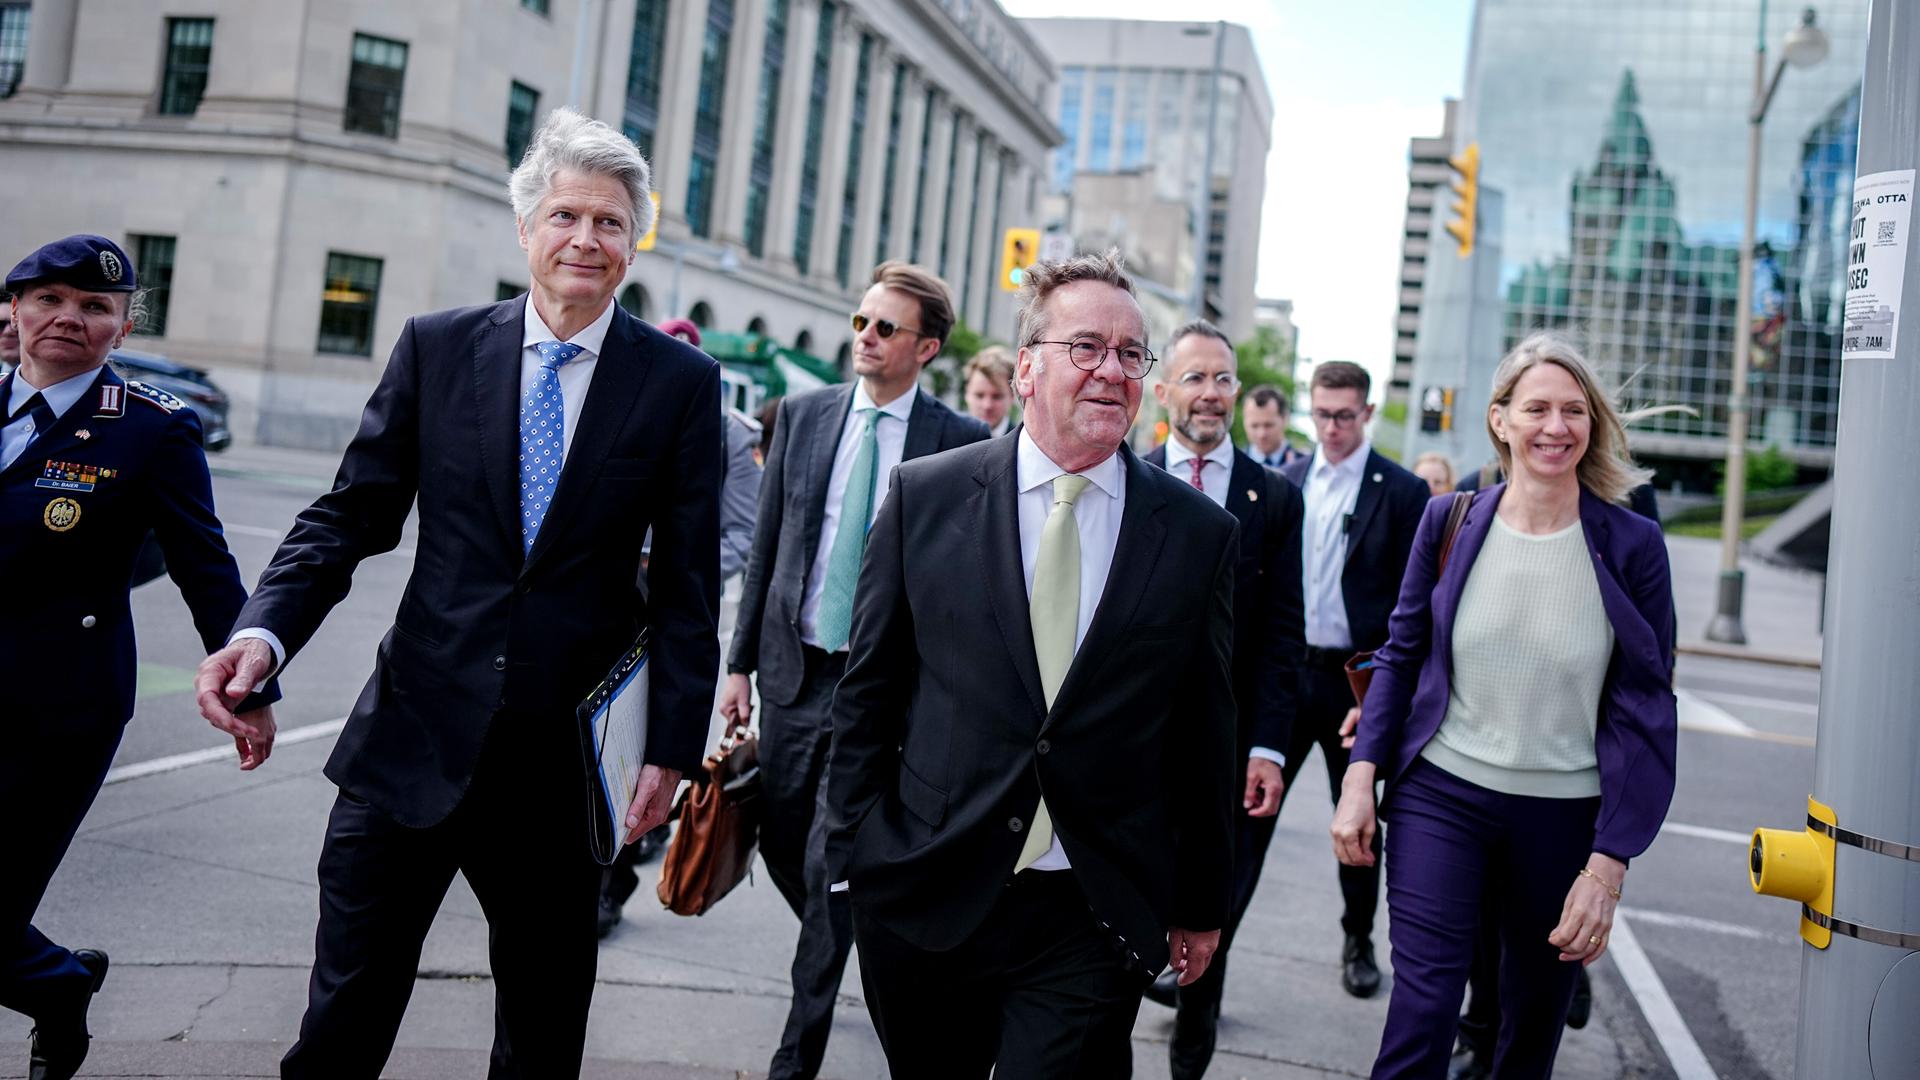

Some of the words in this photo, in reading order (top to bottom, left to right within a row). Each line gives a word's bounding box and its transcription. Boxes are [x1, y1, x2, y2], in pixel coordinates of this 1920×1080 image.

[1877, 193, 1907, 204] OTTA
[1850, 242, 1866, 265] WN
[1865, 336, 1883, 348] 7AM
